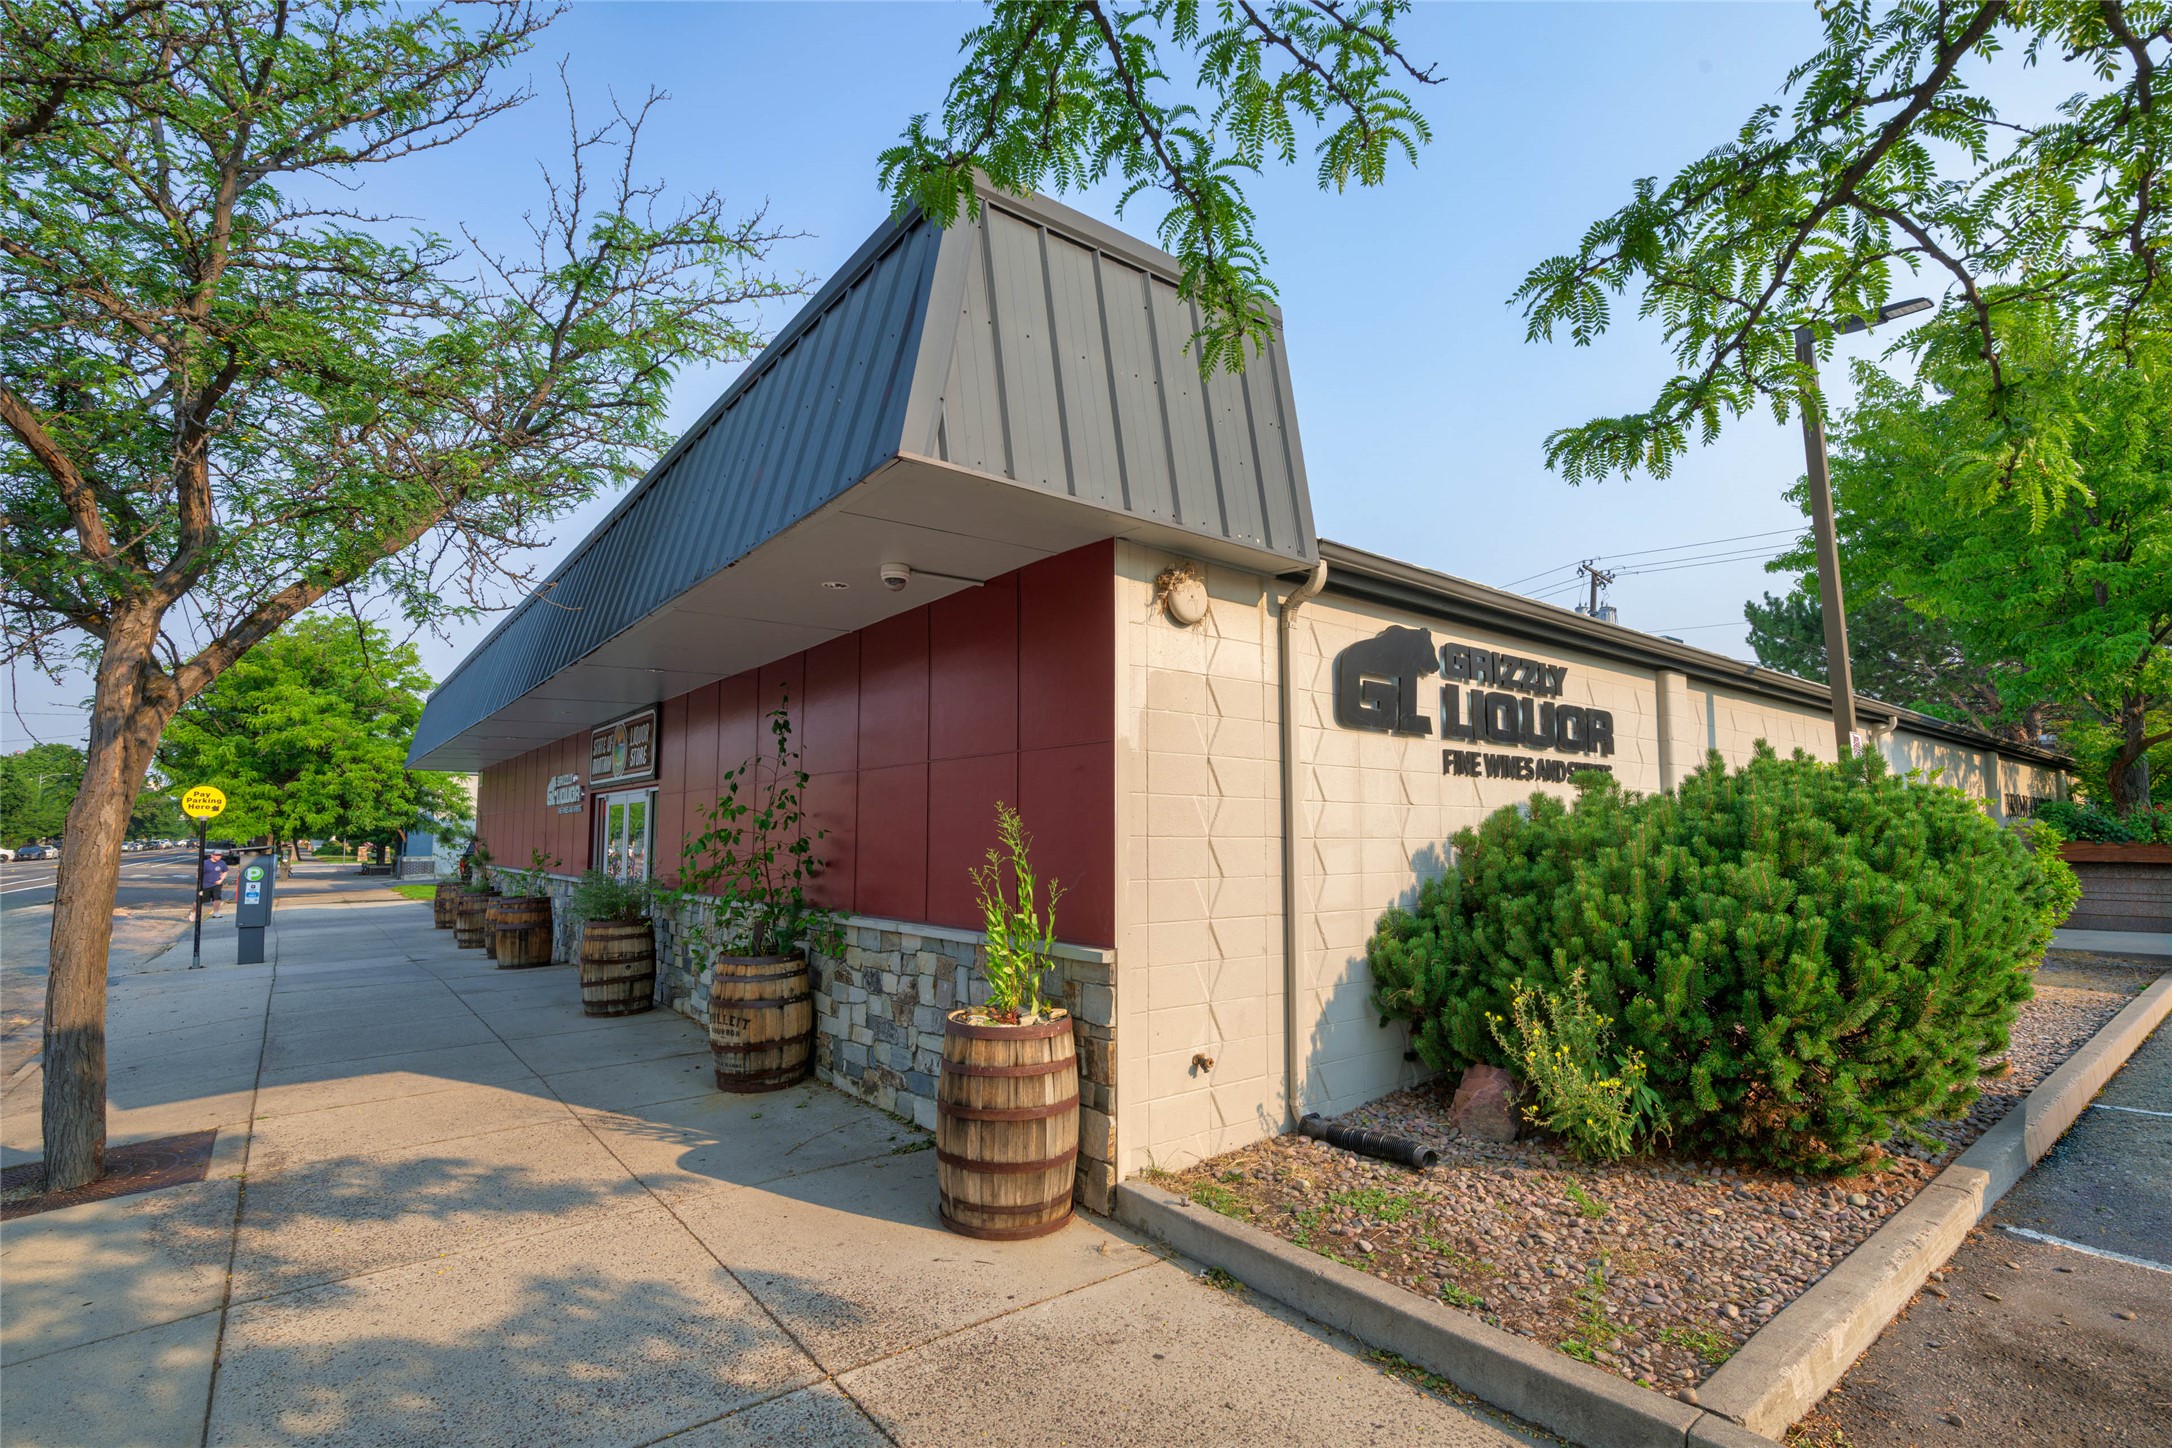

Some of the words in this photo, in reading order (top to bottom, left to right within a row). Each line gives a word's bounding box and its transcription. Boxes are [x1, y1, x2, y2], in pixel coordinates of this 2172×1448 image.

[1440, 642, 1568, 697] GRIZZLY
[1440, 683, 1615, 757] LIQUOR
[630, 744, 647, 767] STORE
[1442, 748, 1482, 777] FINE
[1483, 753, 1534, 781] WINES
[1535, 758, 1567, 784] AND
[186, 797, 222, 805] Parking
[247, 867, 261, 881] P
